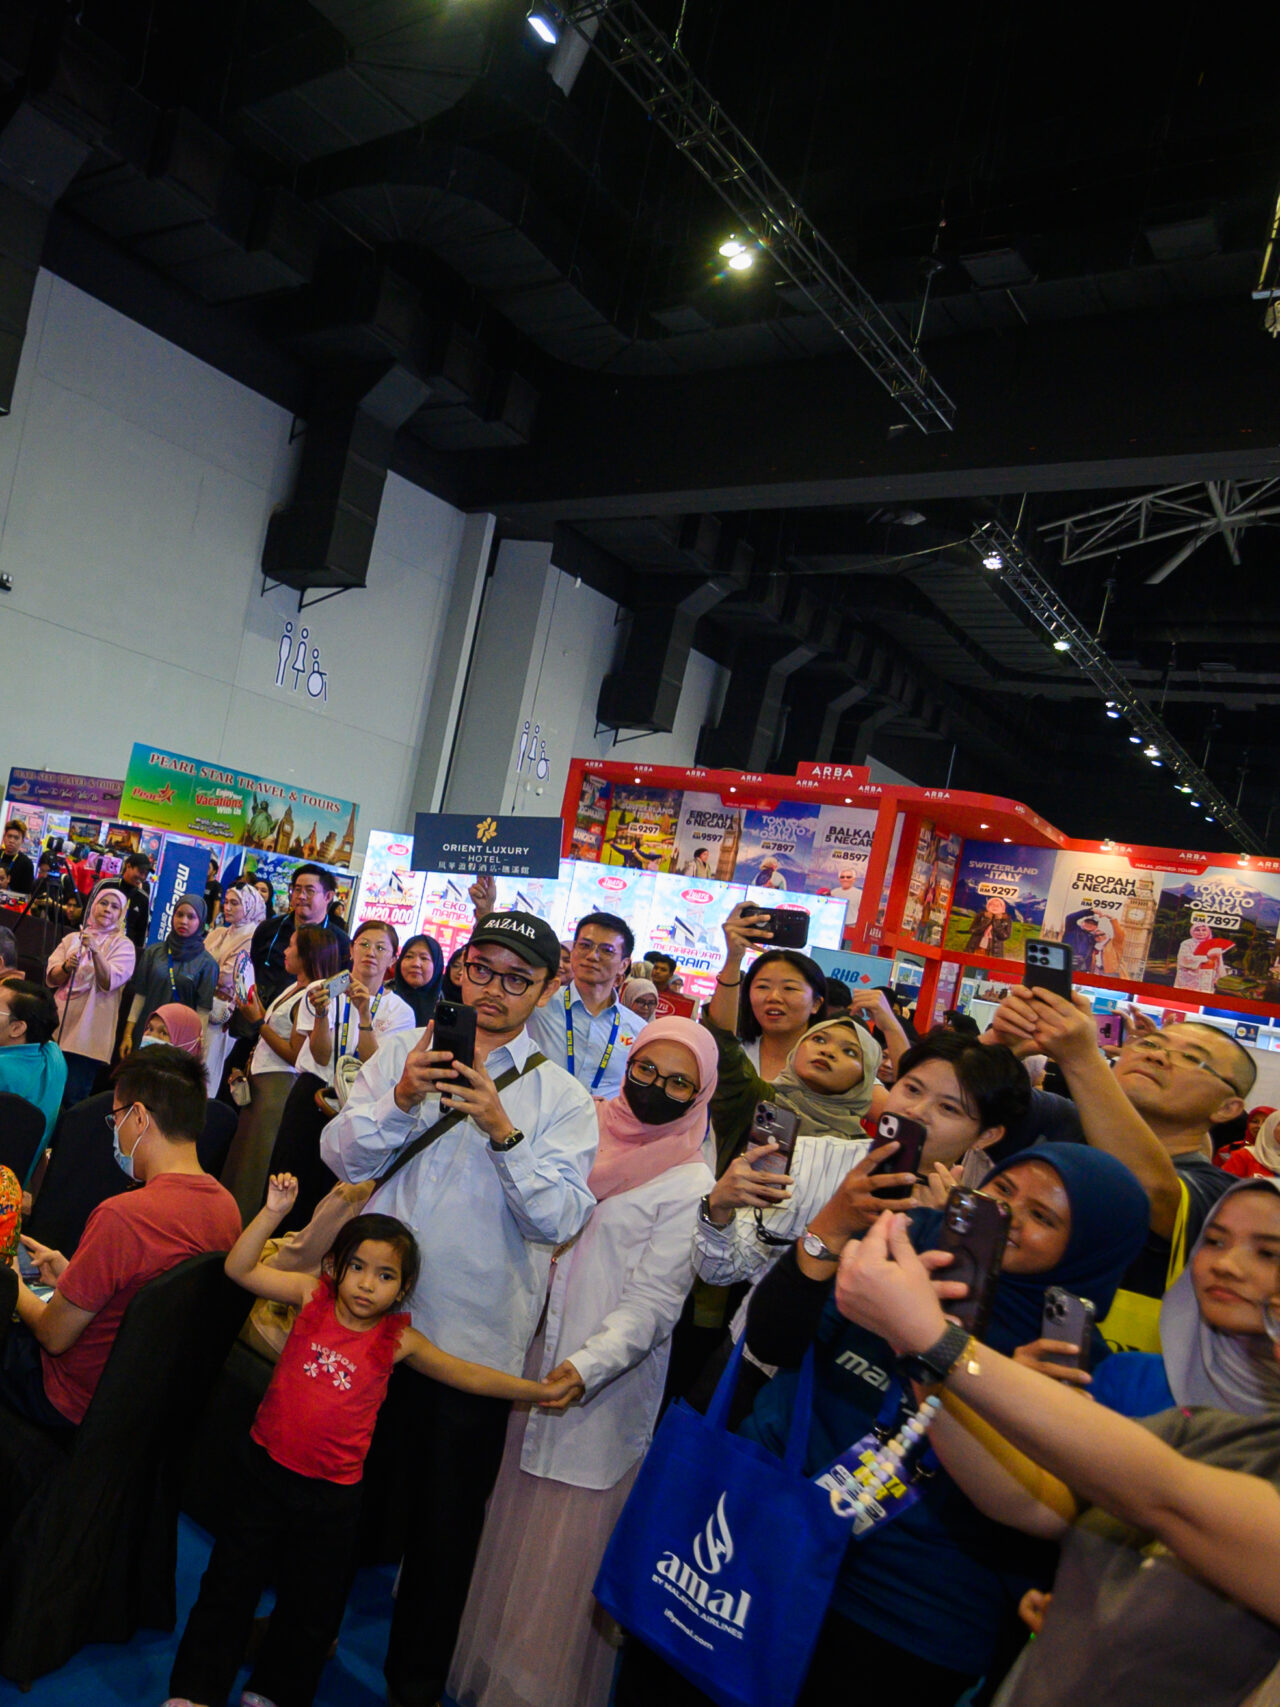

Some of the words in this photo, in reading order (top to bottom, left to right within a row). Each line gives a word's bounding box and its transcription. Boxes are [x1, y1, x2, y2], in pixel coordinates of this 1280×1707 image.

[812, 765, 853, 778] ARBA
[149, 753, 197, 776] PEARL
[199, 767, 234, 785] STAR
[237, 776, 286, 799] TRAVEL
[288, 791, 298, 802] &
[301, 794, 341, 813] TOURS
[740, 774, 762, 782] ARBA
[796, 779, 819, 788] ARBA
[858, 785, 882, 793] ARBA
[924, 790, 950, 799] ARBA
[195, 793, 243, 808] Vacations
[689, 809, 734, 824] EROPAH
[638, 825, 658, 835] 9297
[693, 818, 735, 830] NEGARA
[701, 832, 723, 843] 9597
[825, 834, 831, 842] 5
[834, 836, 873, 847] NEGAR
[442, 843, 483, 853] ORIENT
[485, 846, 530, 855] LUXURY
[771, 842, 795, 852] 7897
[468, 855, 501, 863] HOTEL
[842, 851, 868, 862] 8597
[1179, 852, 1207, 861] ARBA
[968, 860, 1038, 875] SWITZERLAND
[1077, 872, 1136, 889] EROPAH
[991, 886, 1018, 896] 9297
[1071, 882, 1080, 891] 6
[1082, 882, 1137, 898] NEGARA
[1193, 884, 1244, 898] TOKYO
[443, 900, 467, 912] EKO
[1093, 899, 1122, 911] 9597
[432, 908, 475, 924] MAMPU
[1207, 916, 1239, 927] 7897
[484, 918, 535, 939] BAZAAR
[653, 943, 699, 957] MENARA
[700, 951, 722, 961] JAM
[831, 968, 860, 983] RHB
[656, 1551, 752, 1629] amal
[651, 1574, 664, 1585] BY
[700, 1613, 743, 1640] AIRLINES
